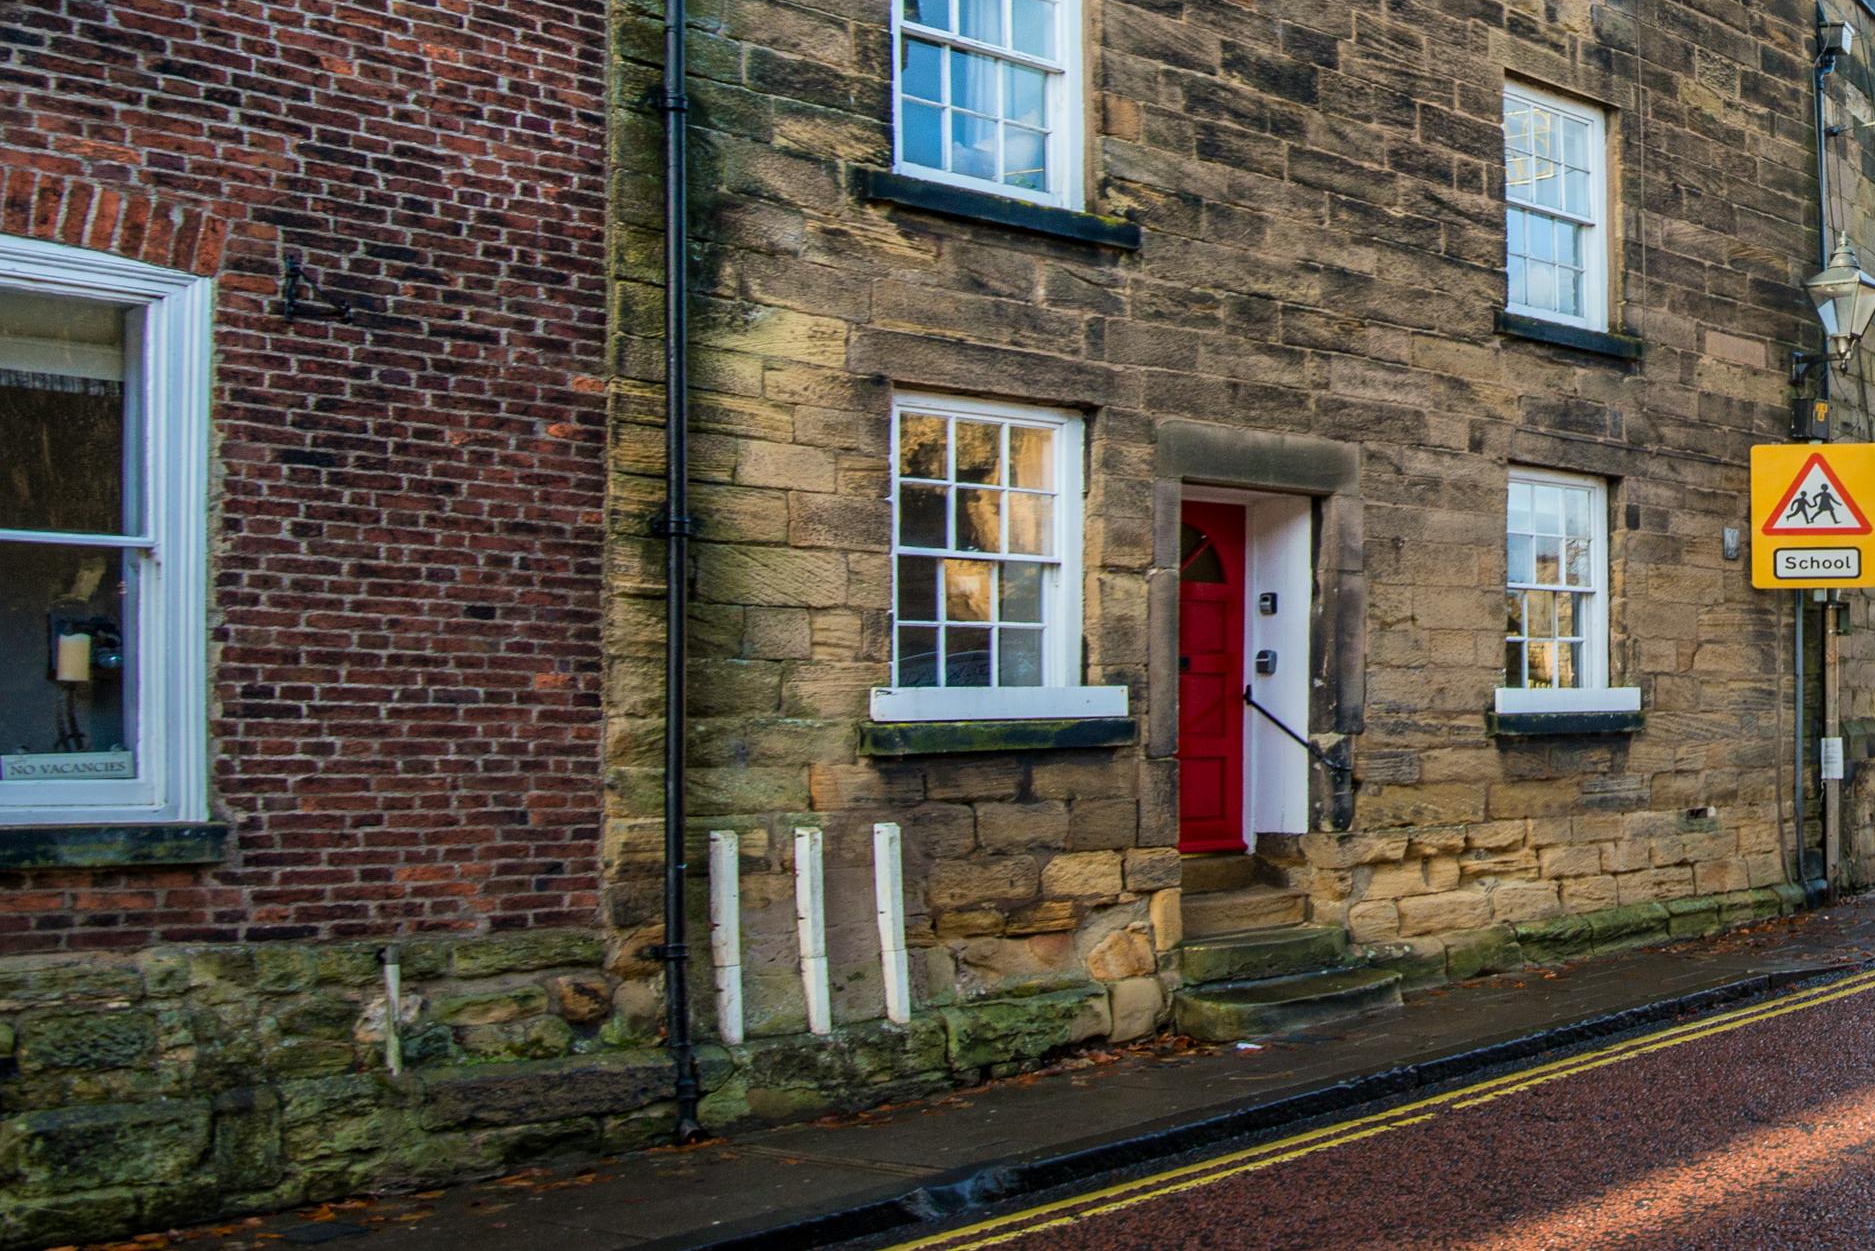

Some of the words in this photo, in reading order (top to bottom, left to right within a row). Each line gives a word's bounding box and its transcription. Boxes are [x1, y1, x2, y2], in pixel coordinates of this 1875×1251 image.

[1785, 556, 1851, 569] School
[10, 764, 36, 775] NO
[40, 761, 126, 774] VACANCIES
